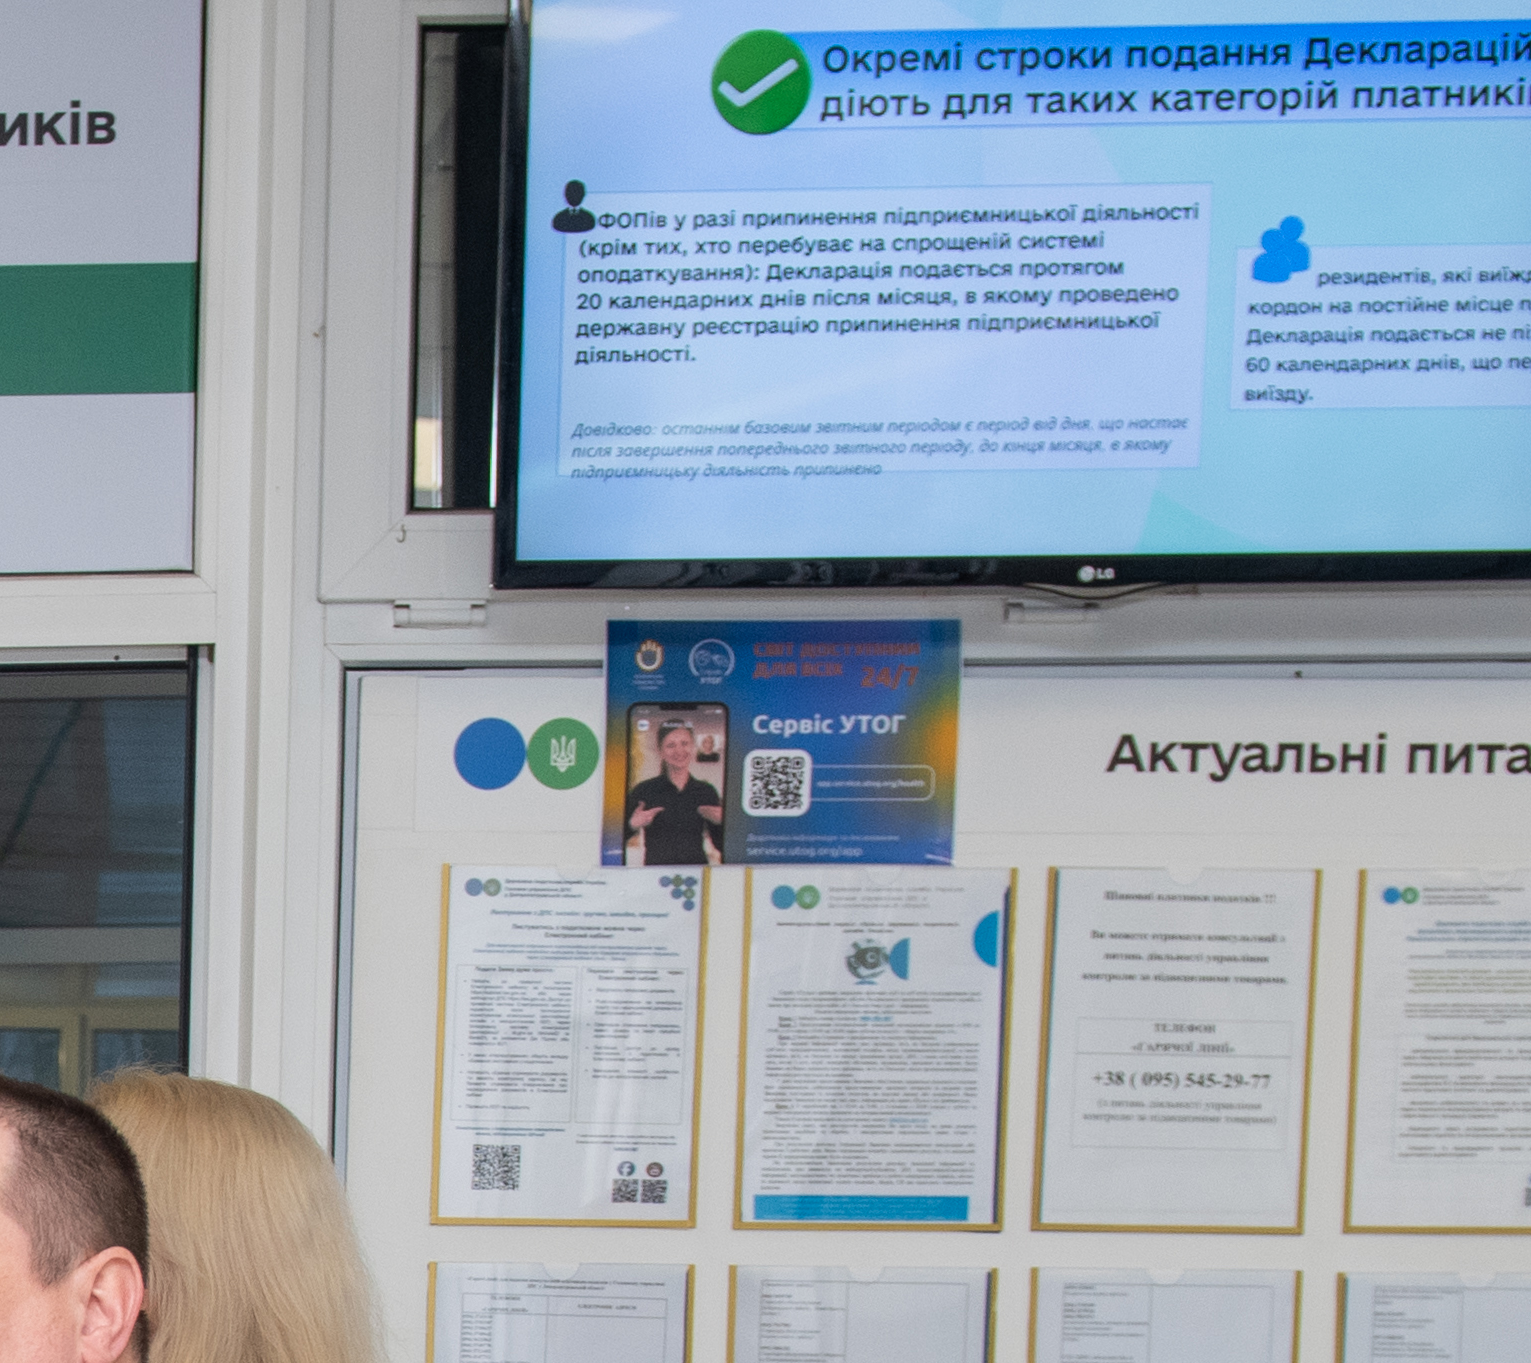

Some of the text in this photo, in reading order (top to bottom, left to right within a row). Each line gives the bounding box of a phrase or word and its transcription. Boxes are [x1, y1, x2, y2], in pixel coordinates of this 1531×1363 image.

[822, 32, 1531, 78] Окремі строки подання Декларацій
[818, 77, 1531, 122] діють для таких категорій платникі
[595, 204, 1199, 232] ФОПів у разі припинення підприємницької діяльності
[578, 231, 1104, 259] (крім тих, хто перебуває на спрощеній системі
[576, 261, 1124, 285] оподаткування): Декларація подається протягом
[1316, 271, 1436, 287] резидентів,
[1441, 270, 1471, 283] які
[575, 287, 1179, 311] 20 календарних днів після місяця, в якому проведено
[1247, 301, 1323, 317] кордон
[1327, 300, 1353, 315] на
[1358, 296, 1449, 314] постійне
[1454, 298, 1514, 313] місце
[574, 311, 1161, 339] державну реєстрацію припинення підприємницької
[1245, 328, 1364, 346] Декларація
[1369, 328, 1475, 344] подається
[1480, 327, 1507, 342] не
[573, 346, 696, 365] діяльності.
[1244, 356, 1271, 373] 60
[1275, 358, 1411, 374] календарних
[1414, 354, 1465, 372] днів,
[1471, 356, 1503, 371] що
[1243, 384, 1313, 405] виїзду.
[1092, 567, 1115, 580] LG
[1105, 733, 1531, 782] Актуальні пита
[1092, 1069, 1126, 1088] +38
[1184, 1071, 1272, 1089] 545-29-77
